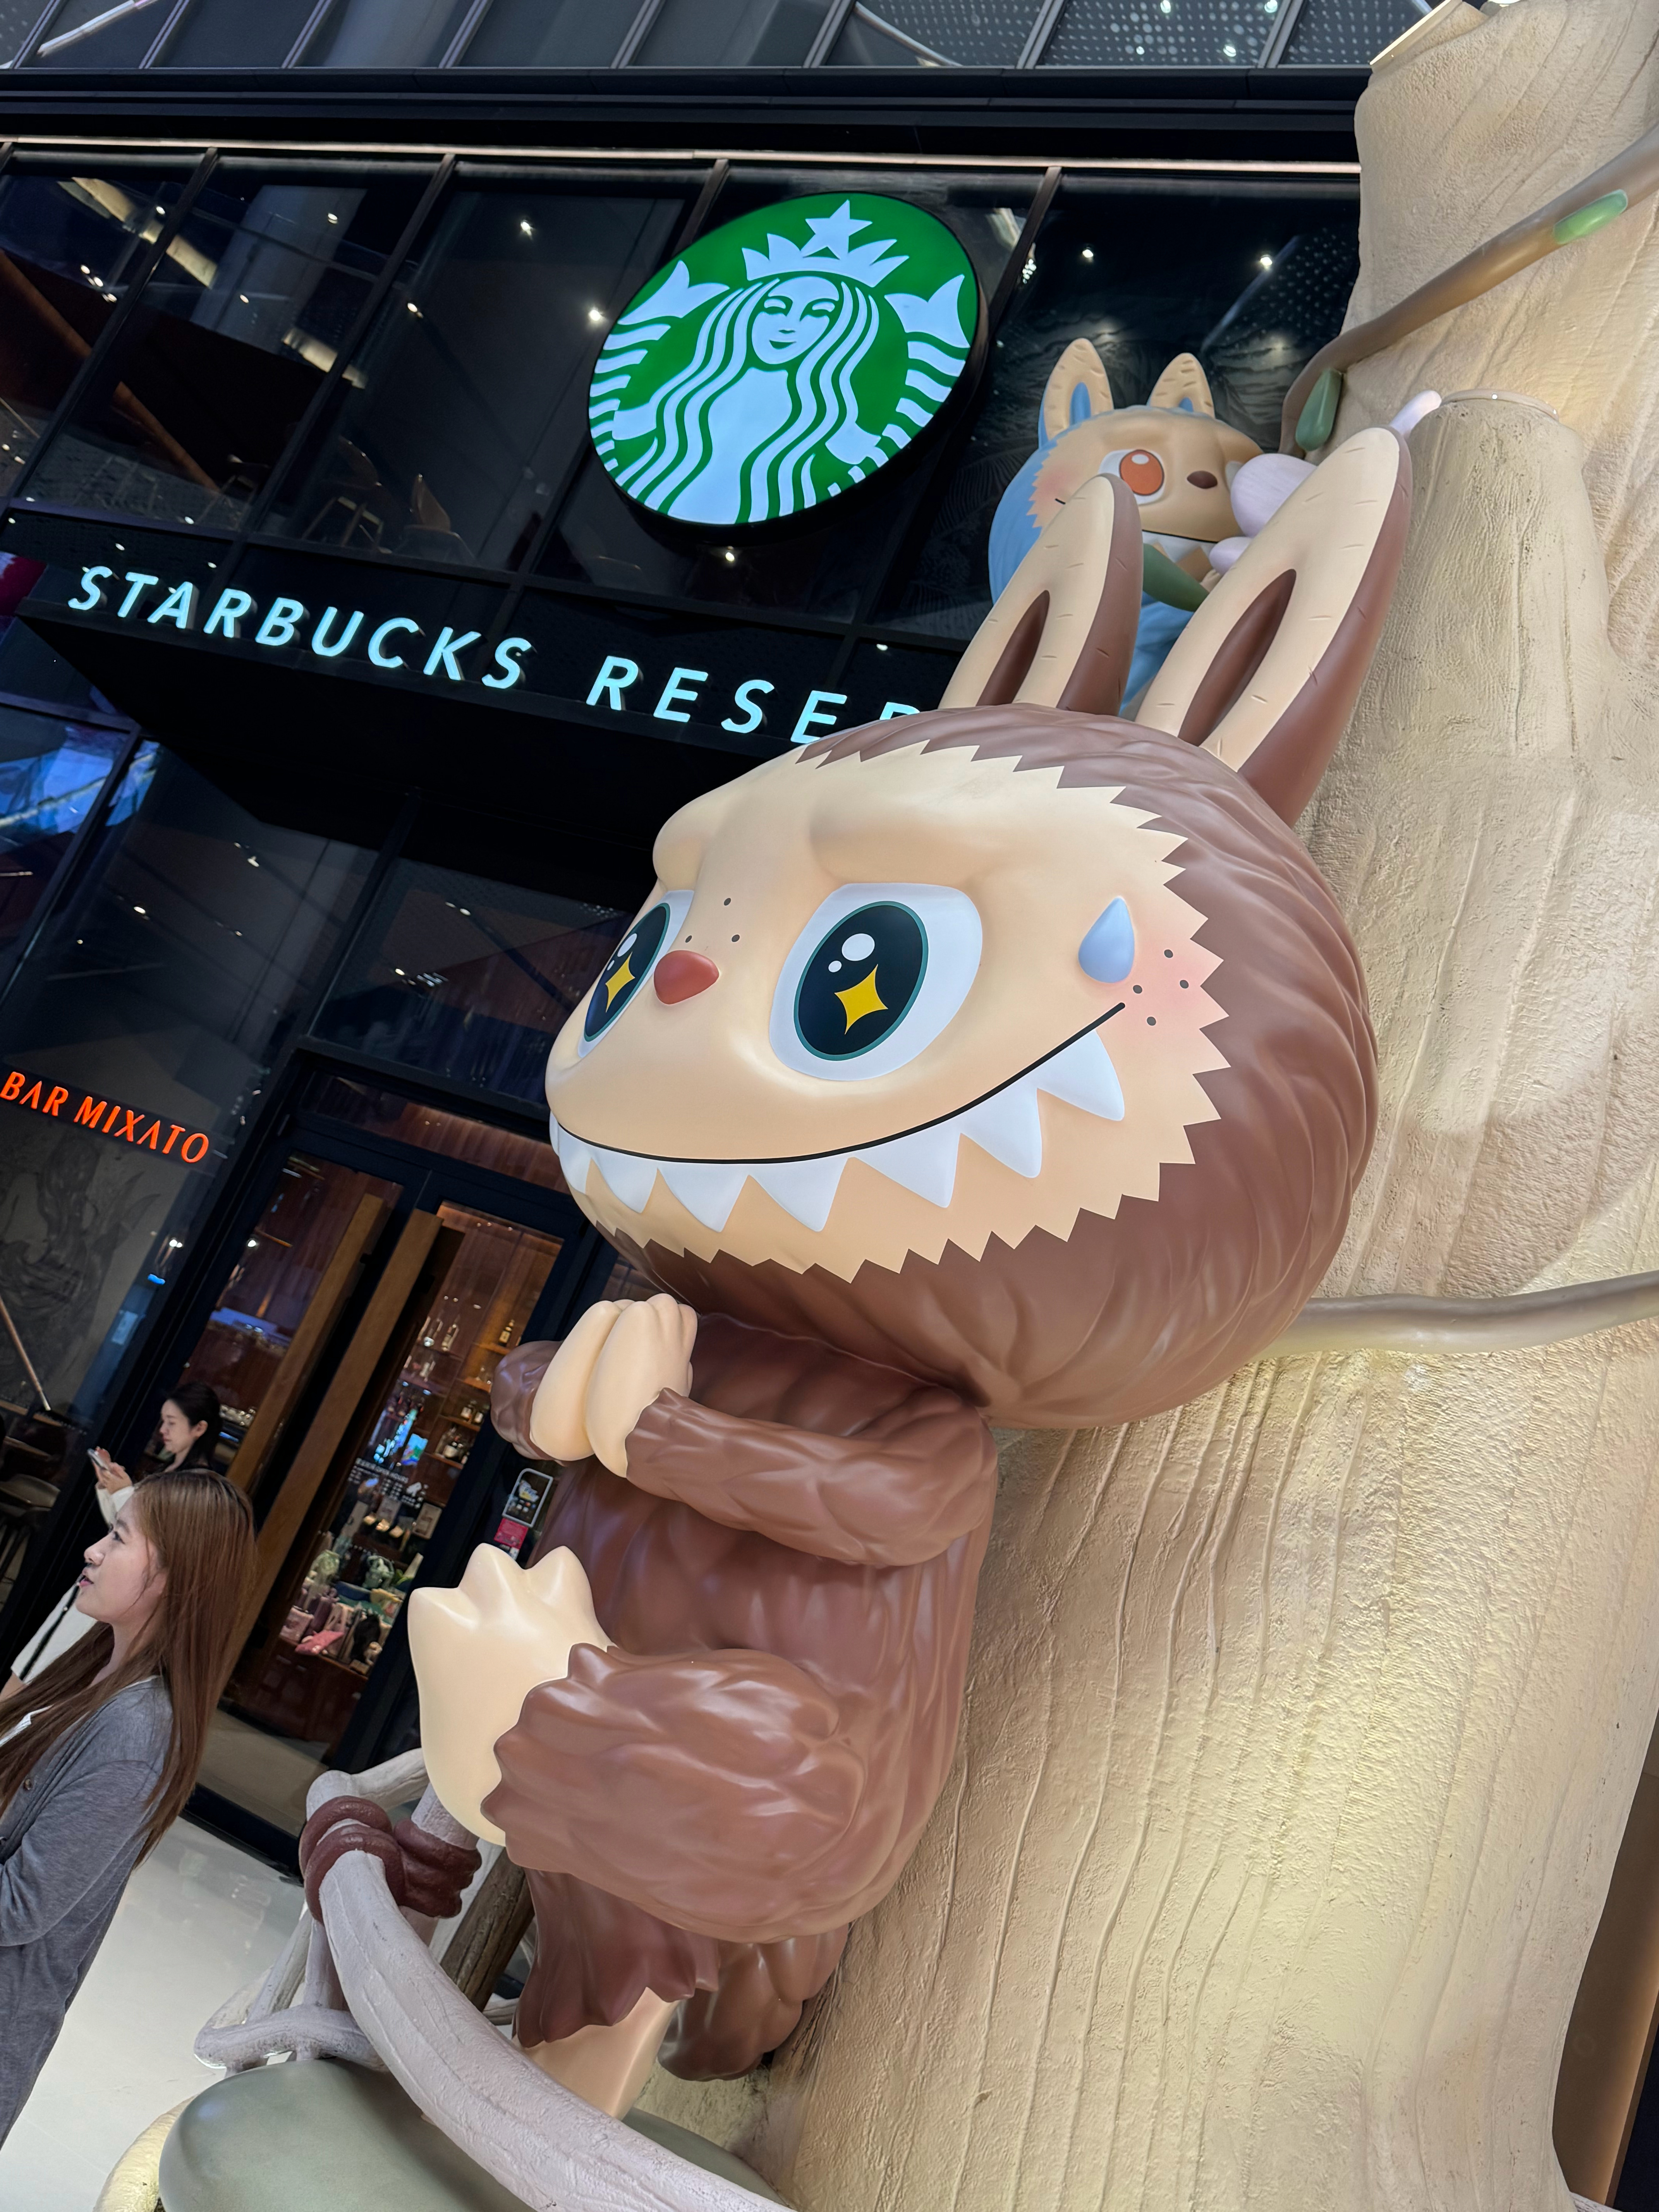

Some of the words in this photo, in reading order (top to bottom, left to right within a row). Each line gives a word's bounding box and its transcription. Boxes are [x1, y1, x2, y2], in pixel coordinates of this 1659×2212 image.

[68, 565, 532, 689] STARBUCKS
[0, 1071, 69, 1116] BAR
[74, 1096, 209, 1163] MIXATO
